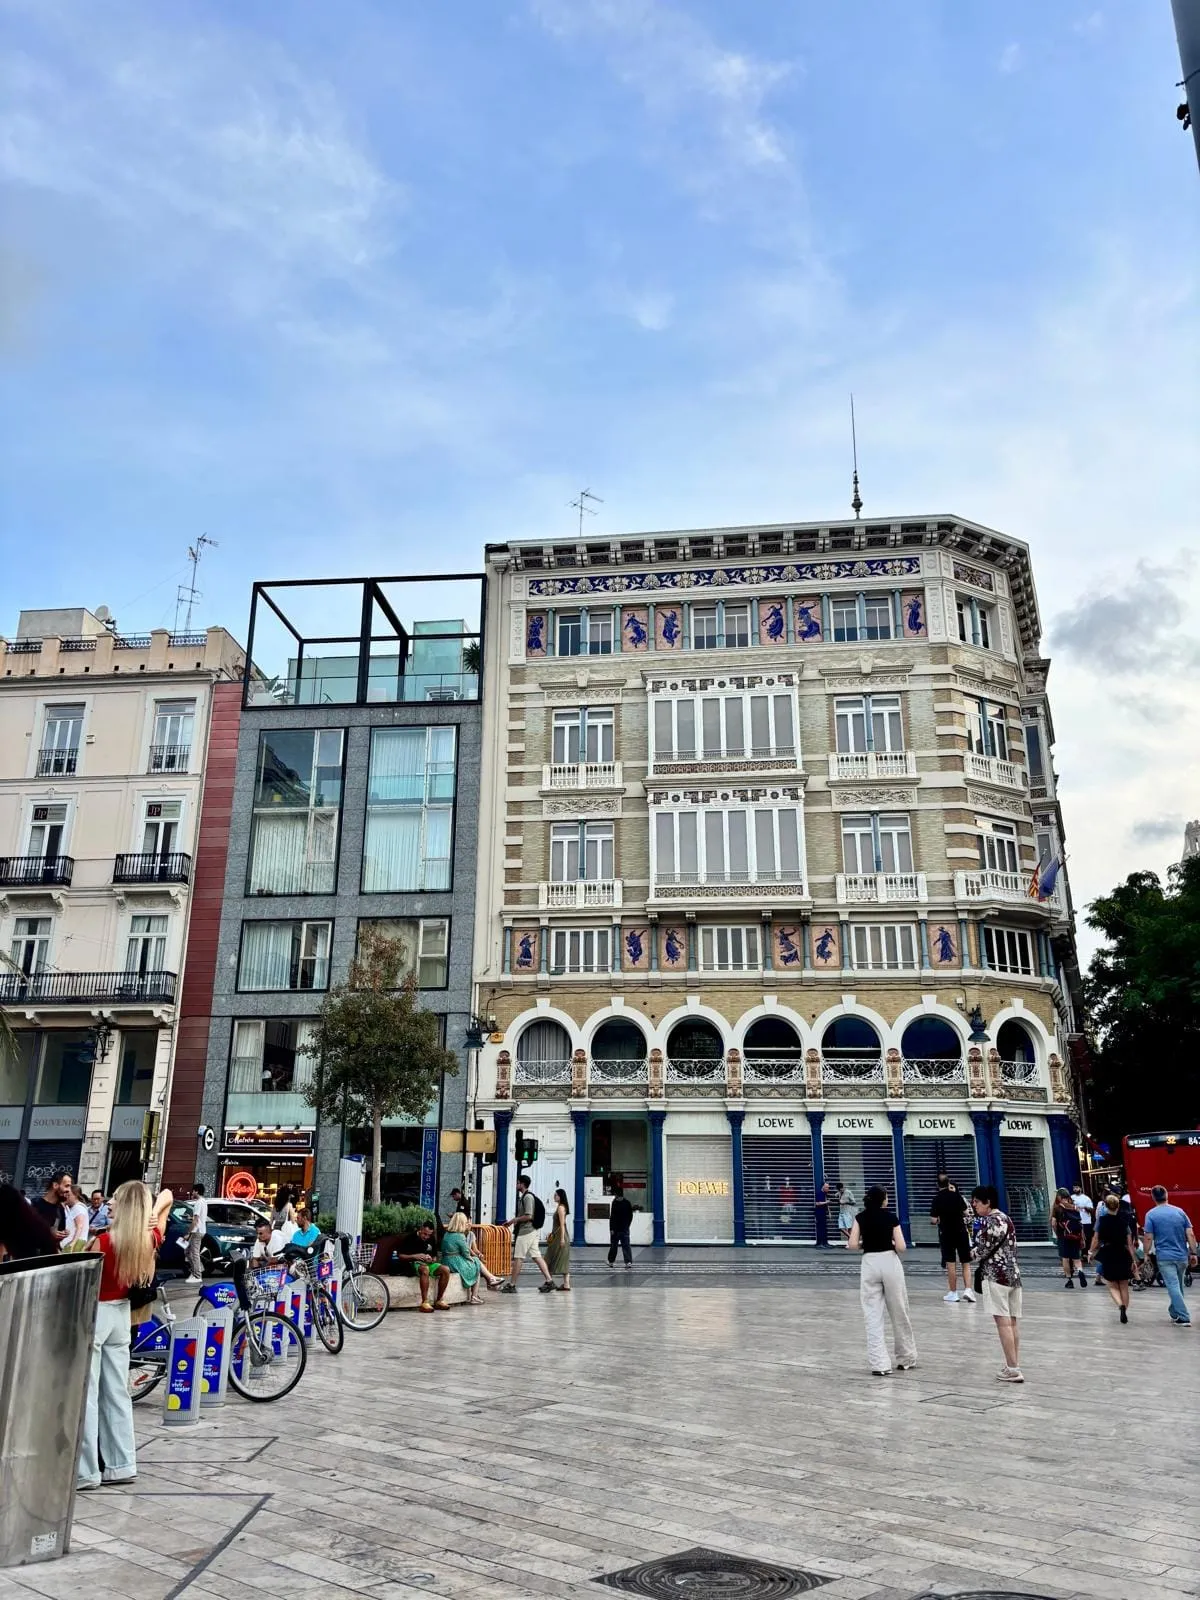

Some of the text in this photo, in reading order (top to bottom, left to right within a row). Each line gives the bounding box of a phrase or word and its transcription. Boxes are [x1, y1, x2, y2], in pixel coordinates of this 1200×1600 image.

[33, 1118, 82, 1127] SOUVENIRS
[758, 1118, 795, 1129] LOEWE
[837, 1118, 874, 1129] LOEWE
[919, 1119, 956, 1129] LOEWE
[1007, 1120, 1033, 1131] LOEWE
[1166, 1135, 1177, 1145] 32
[425, 1150, 434, 1209] Recasen
[679, 1181, 728, 1194] LOEWE
[217, 1296, 235, 1304] mejor
